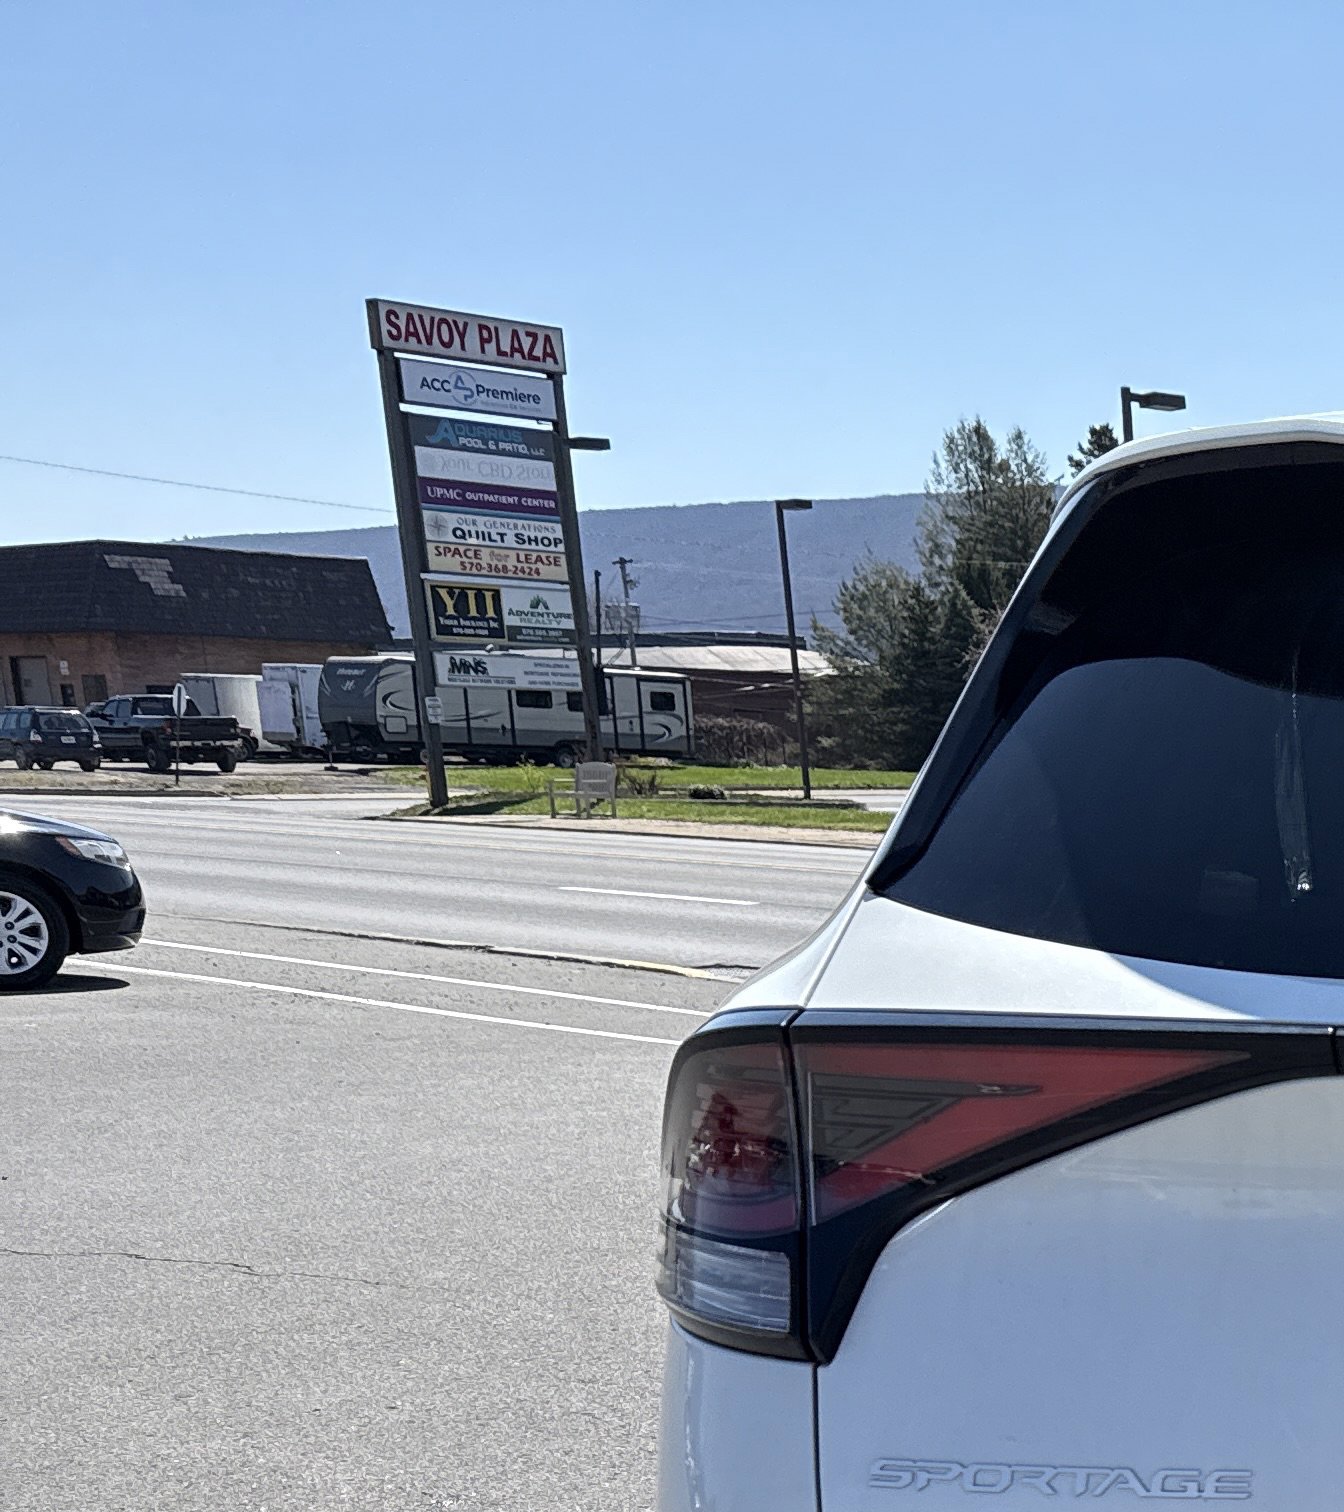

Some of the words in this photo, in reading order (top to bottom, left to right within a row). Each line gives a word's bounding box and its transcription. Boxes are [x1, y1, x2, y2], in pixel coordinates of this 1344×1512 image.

[385, 309, 469, 351] SAVOY
[478, 323, 559, 366] PLAZA
[420, 376, 452, 393] ACC
[475, 384, 541, 404] Premiere
[425, 419, 522, 447] AQUARIUS
[459, 436, 487, 449] POOL
[488, 440, 497, 450] &
[531, 447, 545, 456] LLC
[426, 486, 462, 500] UPMC
[465, 491, 518, 504] OUTPATIENT
[521, 497, 556, 508] CENTER
[457, 517, 478, 528] OUR
[484, 519, 556, 534] GENERATIONS
[452, 527, 507, 543] QUILT
[514, 532, 563, 548] SHOP
[434, 545, 482, 560] SPACE
[516, 552, 562, 567] LEASE
[460, 561, 541, 577] 570-368-2424
[436, 587, 498, 618] YII
[508, 607, 572, 620] ADVENTURE
[520, 617, 562, 626] REALTY
[868, 1456, 1254, 1500] SPORTAGE
